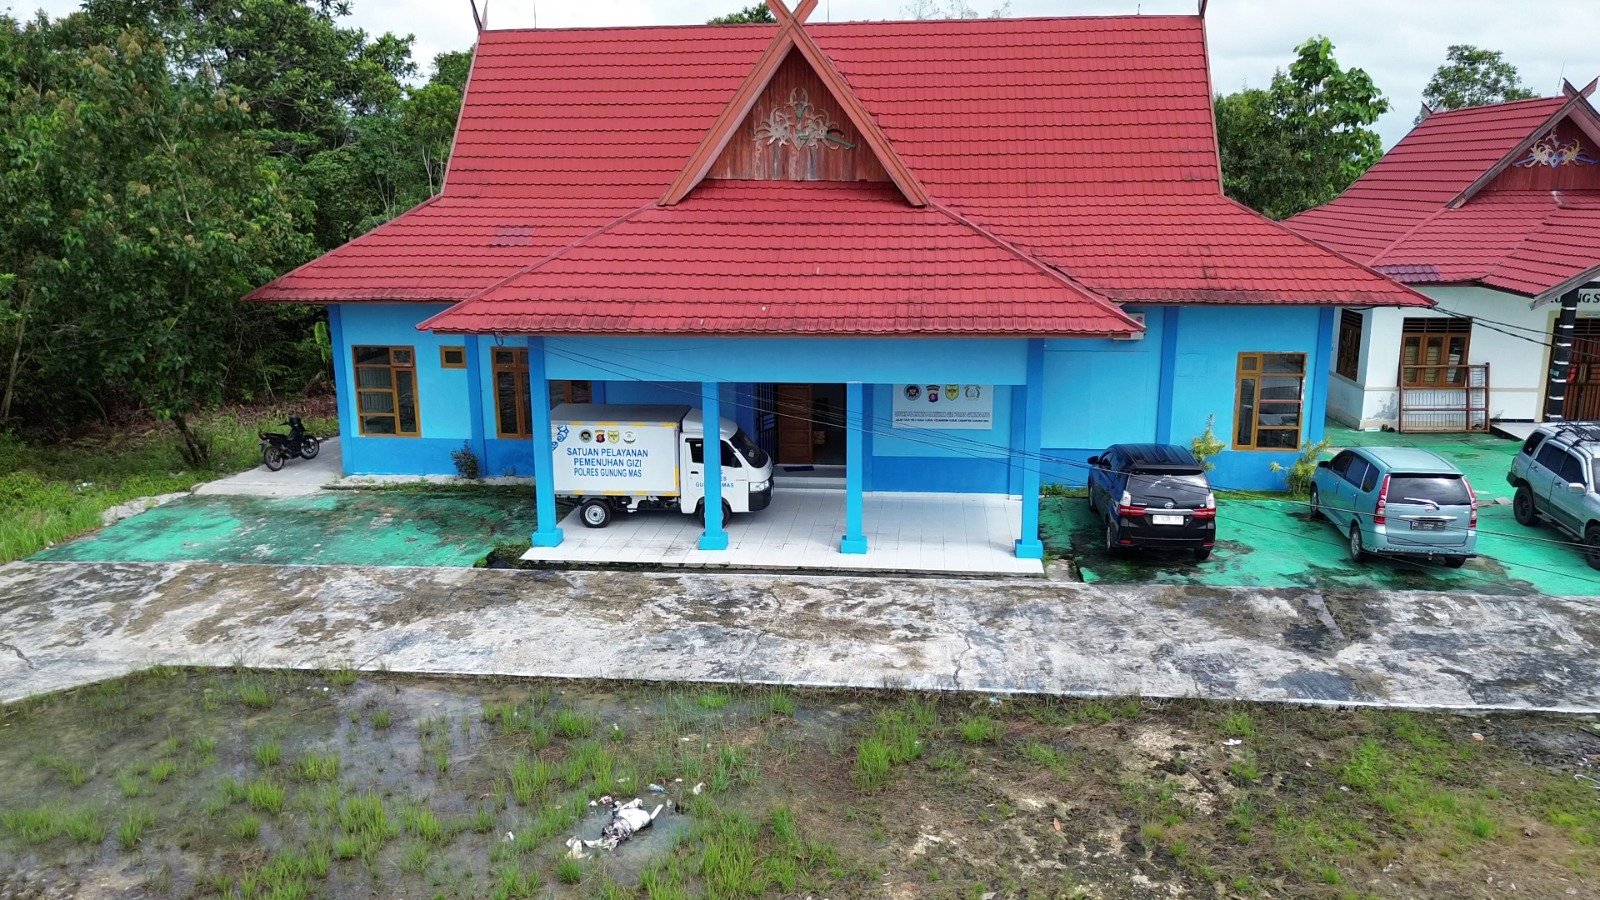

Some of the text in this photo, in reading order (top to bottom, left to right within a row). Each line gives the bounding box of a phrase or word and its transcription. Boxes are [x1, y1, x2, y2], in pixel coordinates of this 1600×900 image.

[566, 448, 648, 457] SATUAN PELAYANAN
[573, 458, 642, 467] PEMENUHAN GIZI
[574, 468, 642, 477] POLRES GUNUNG MAS
